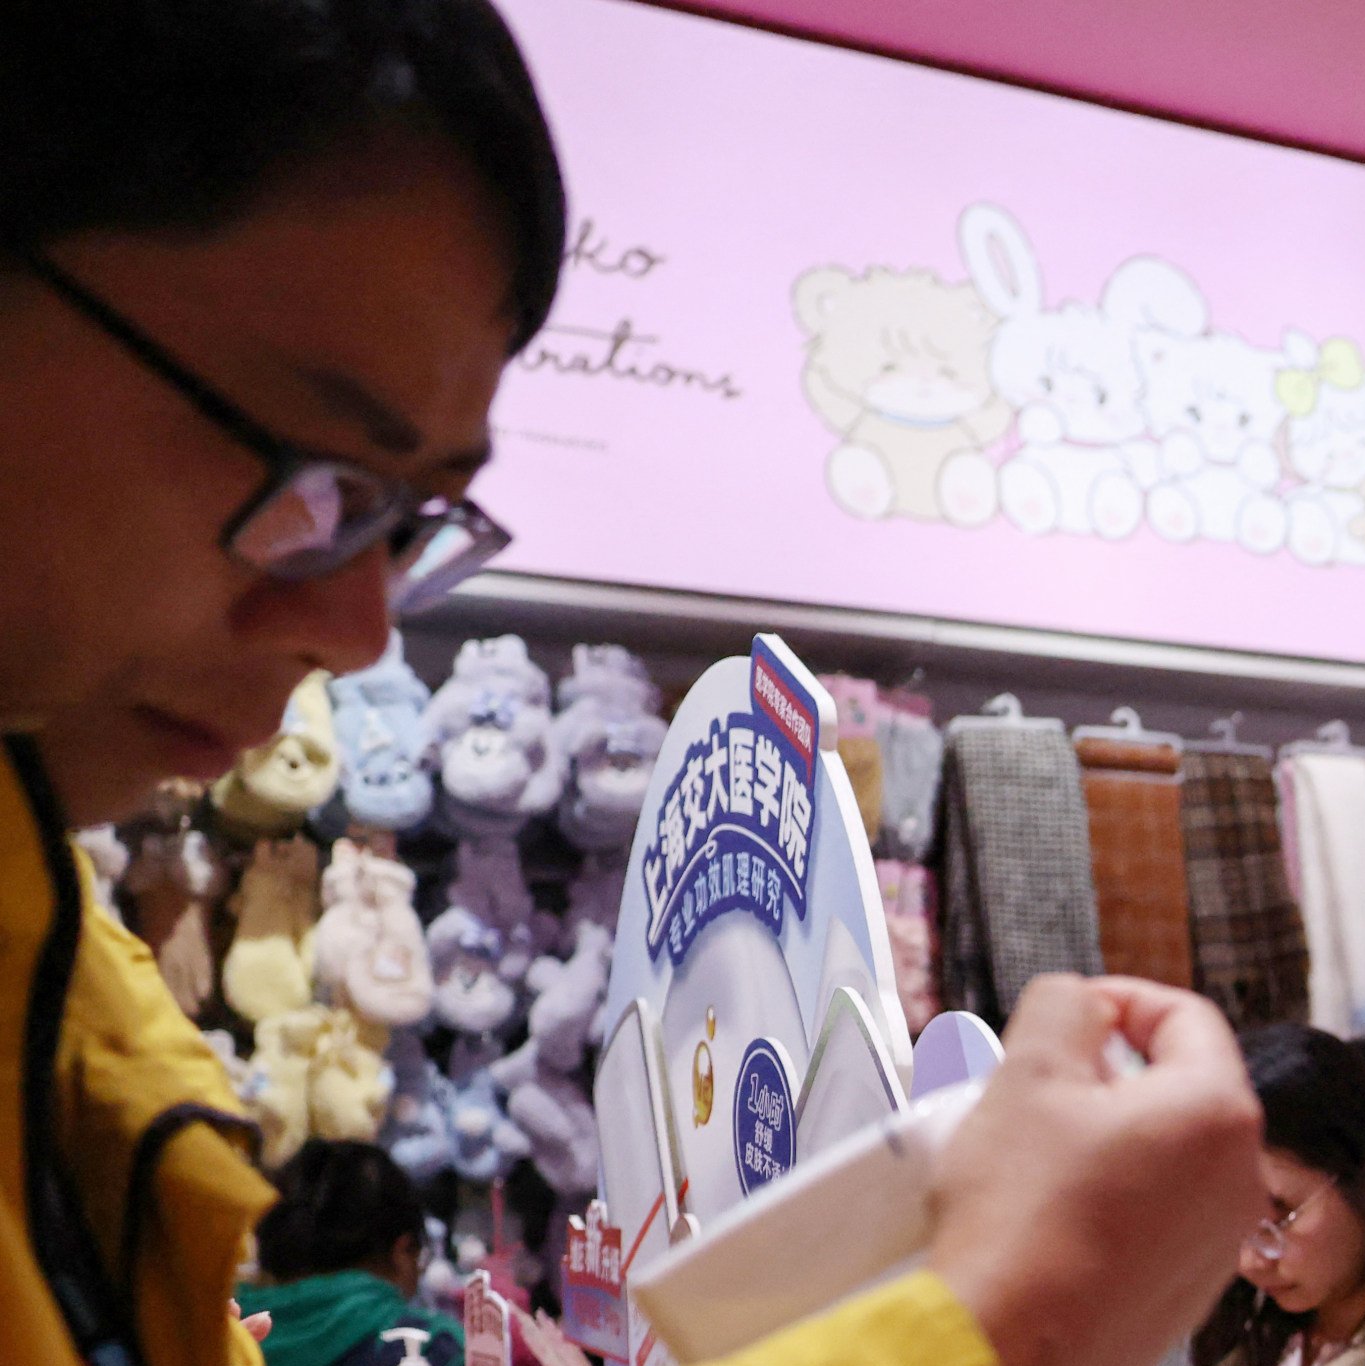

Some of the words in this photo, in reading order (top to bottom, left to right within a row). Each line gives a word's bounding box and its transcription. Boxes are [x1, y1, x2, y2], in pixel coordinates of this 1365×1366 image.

[644, 726, 812, 948] 上海交大医学院
[668, 851, 782, 953] 专业功效肌理研究
[747, 1072, 783, 1131] 1小时
[754, 1119, 773, 1154] 舒缓
